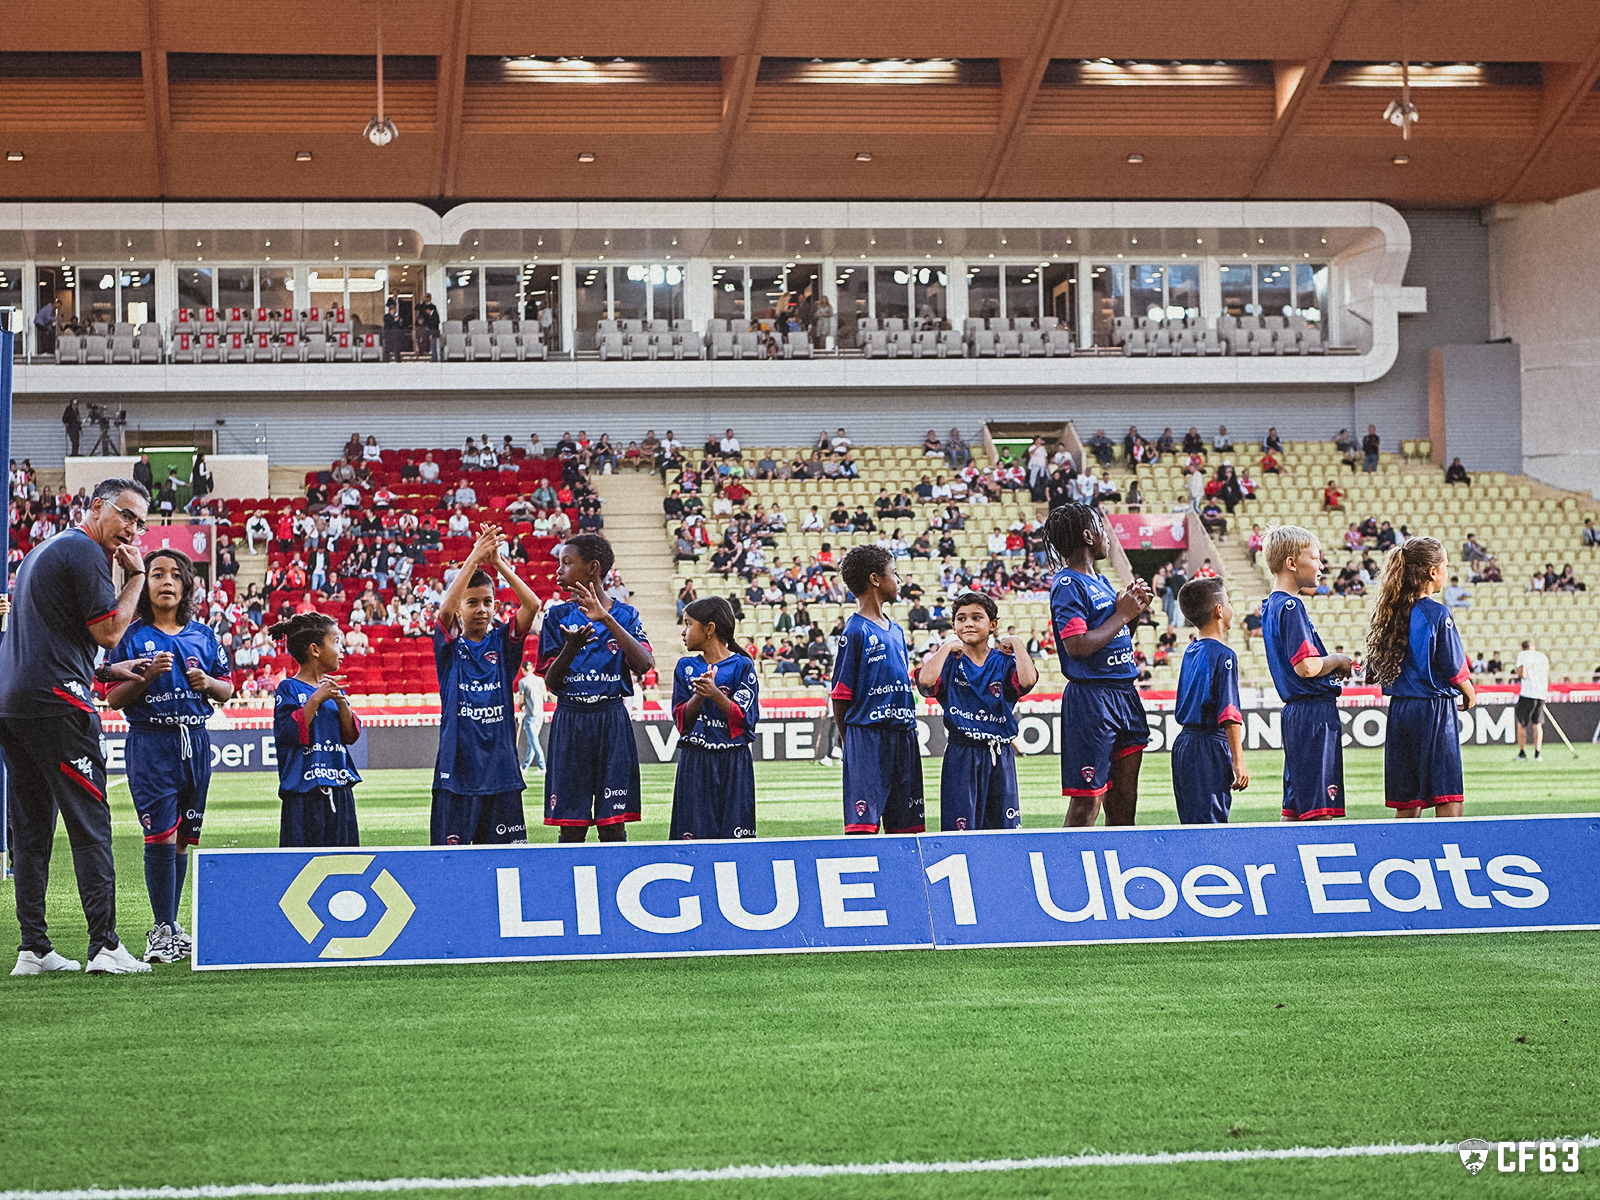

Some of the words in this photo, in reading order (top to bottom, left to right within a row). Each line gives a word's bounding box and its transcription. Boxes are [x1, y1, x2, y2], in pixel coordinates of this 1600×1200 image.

[145, 691, 174, 703] Crédit
[497, 856, 889, 938] LIGUE
[925, 853, 978, 926] 1
[1028, 849, 1277, 923] Uber
[1297, 842, 1550, 915] Eats
